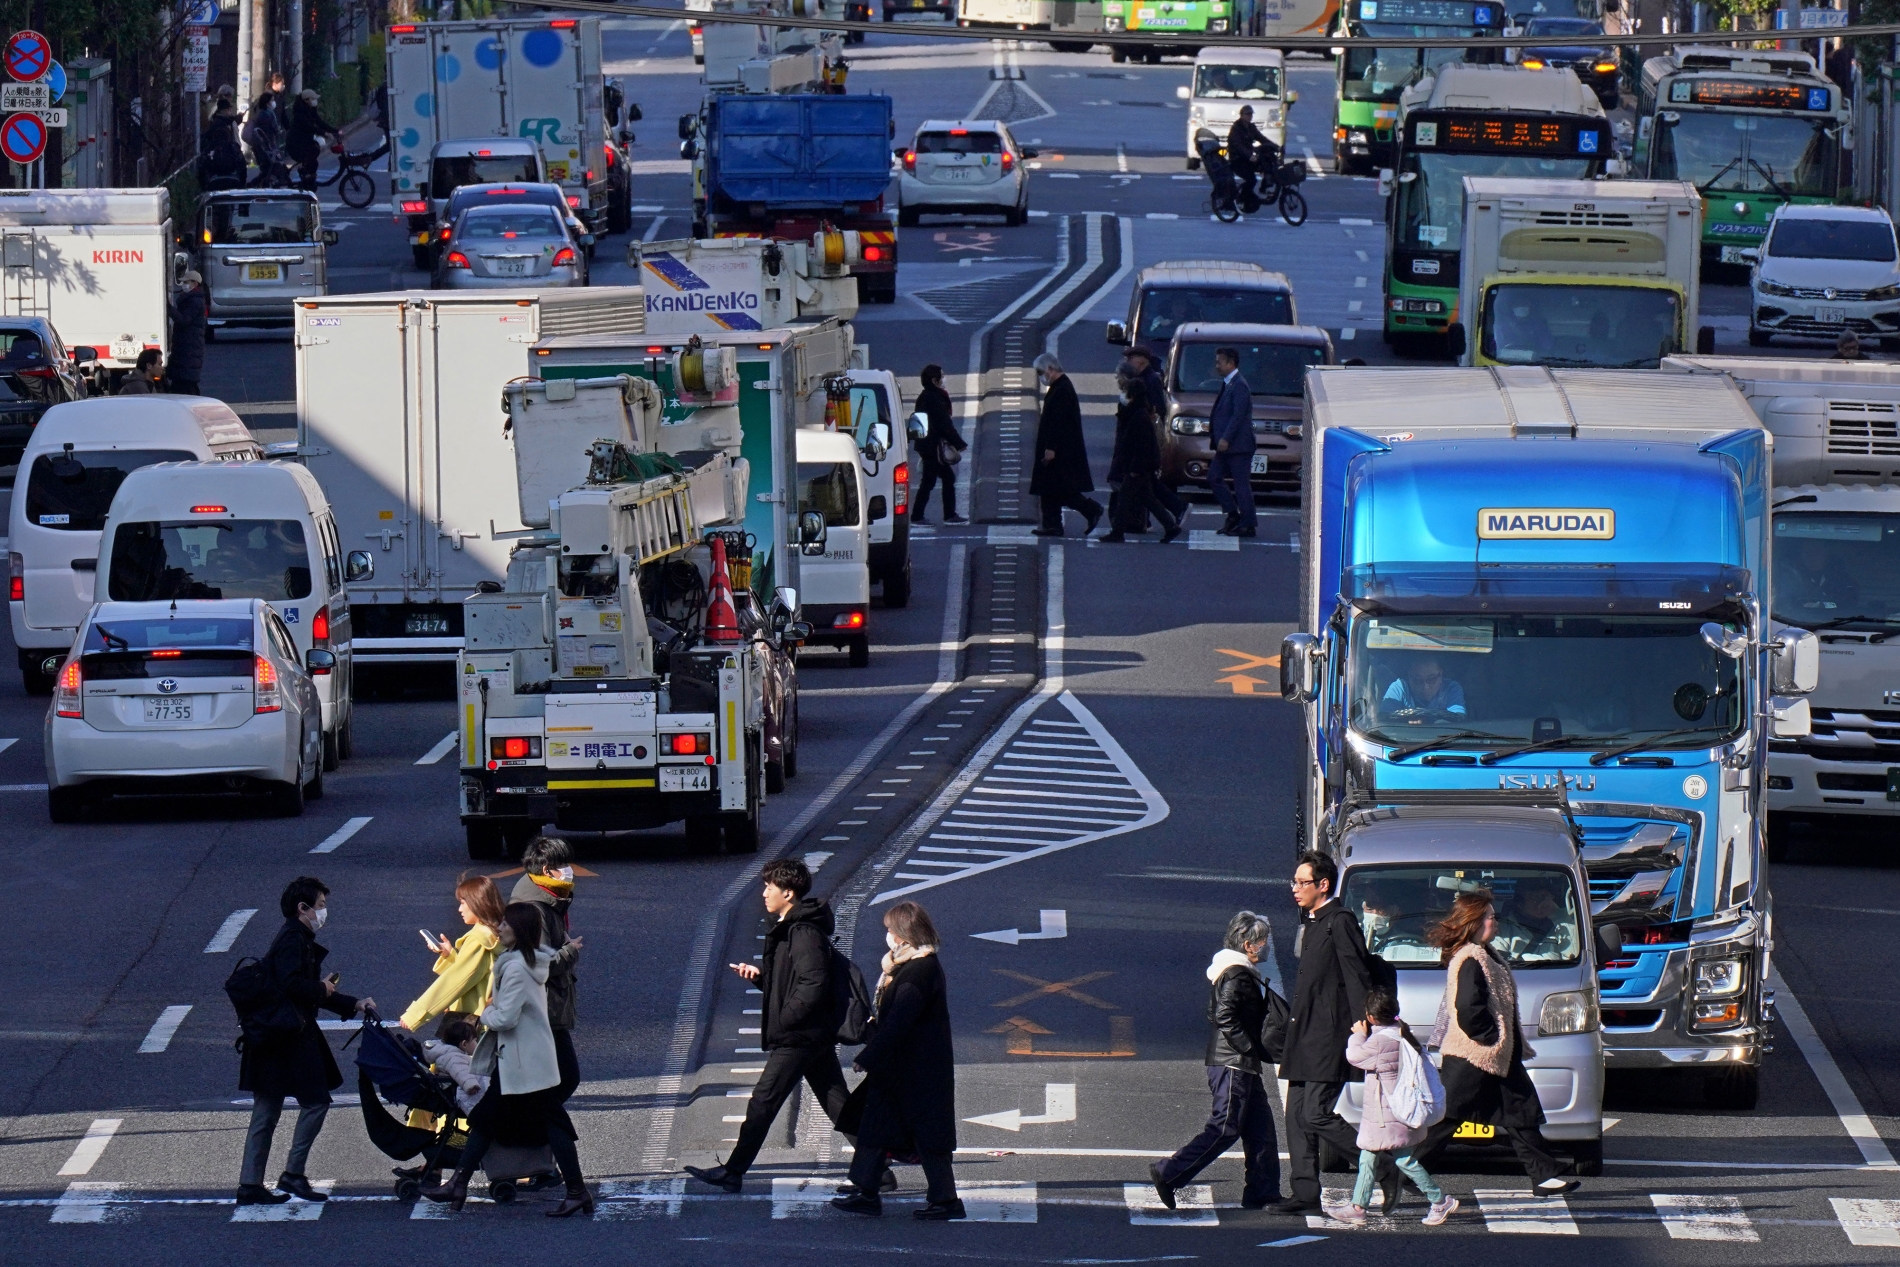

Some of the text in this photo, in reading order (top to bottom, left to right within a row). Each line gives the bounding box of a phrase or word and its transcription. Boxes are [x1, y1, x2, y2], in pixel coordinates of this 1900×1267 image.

[4, 86, 47, 96] 人の乗降を除く
[4, 98, 47, 108] 日曜・休日を除く
[92, 249, 144, 264] KIRIN
[1488, 515, 1605, 531] MARUDAI
[414, 620, 447, 632] 34-74
[170, 698, 183, 706] 302
[155, 706, 191, 719] 77-55
[584, 742, 633, 758] 関電工
[672, 768, 700, 776] 江東 800
[1499, 774, 1596, 792] ISUZU
